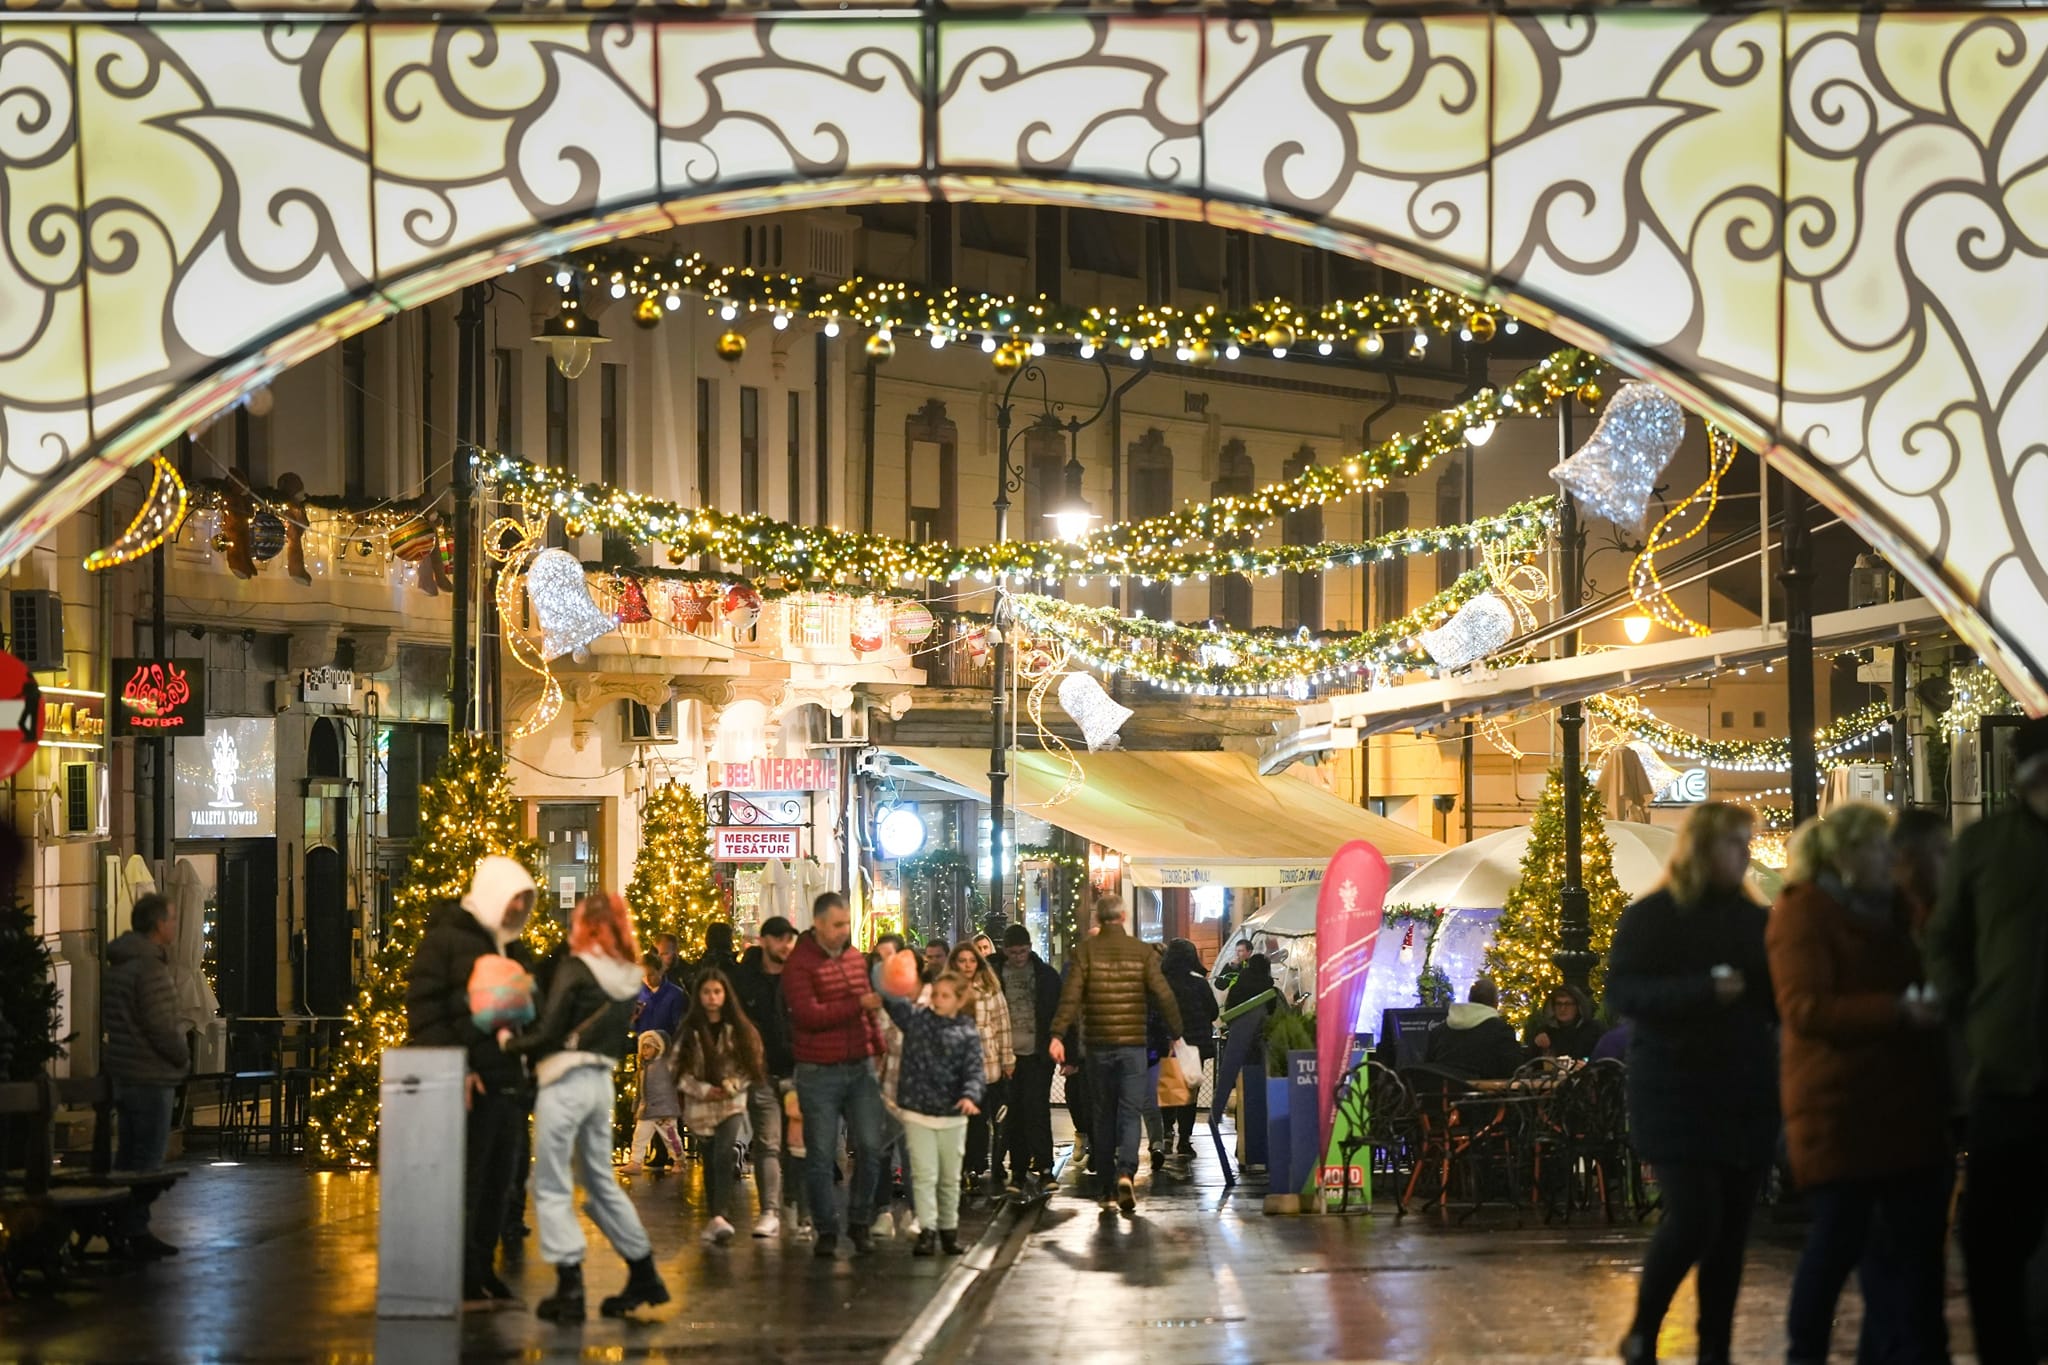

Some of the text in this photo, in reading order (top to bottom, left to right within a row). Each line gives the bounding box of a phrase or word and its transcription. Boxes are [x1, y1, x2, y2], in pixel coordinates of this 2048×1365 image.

[130, 716, 184, 728] SHOT BAR
[760, 758, 837, 790] MERCERIE
[191, 810, 258, 825] VALLETTA TOWERS
[724, 833, 790, 843] MERCERIE
